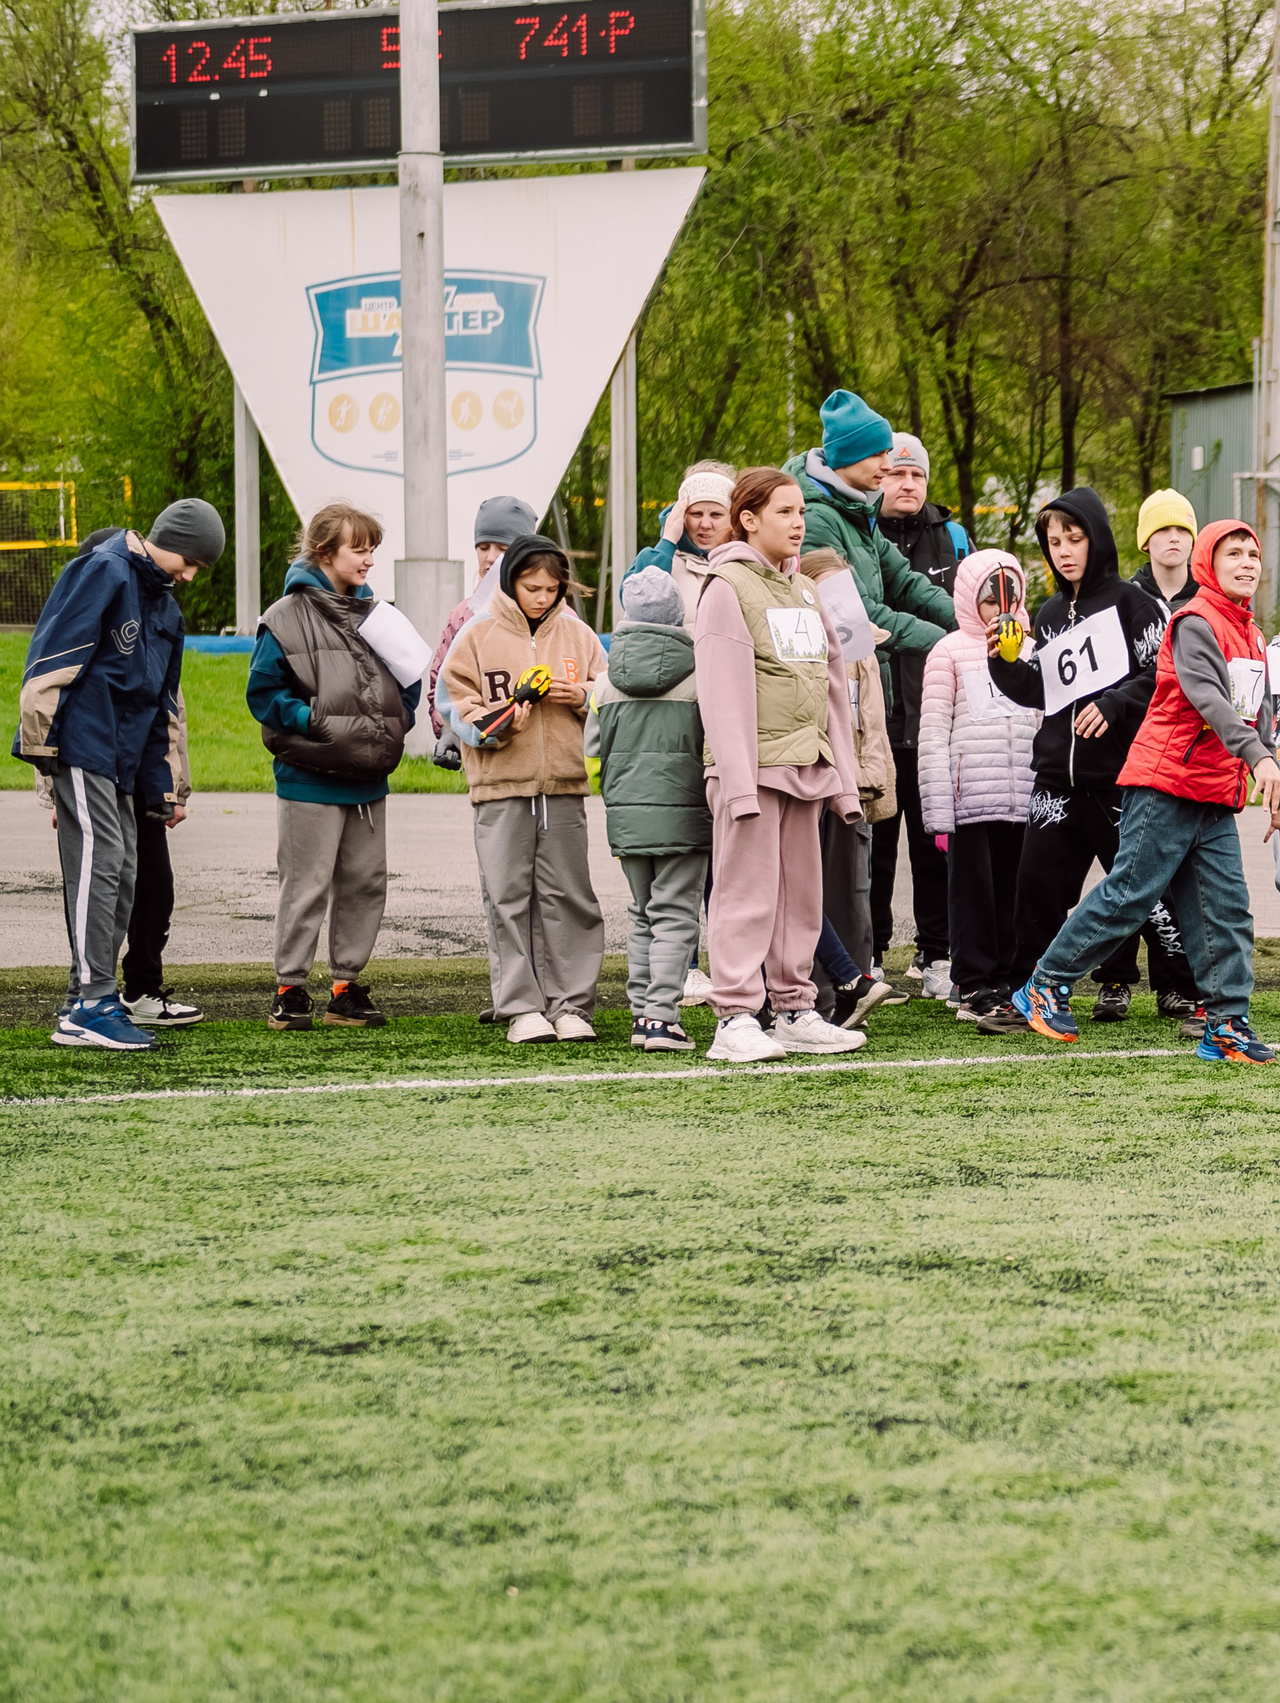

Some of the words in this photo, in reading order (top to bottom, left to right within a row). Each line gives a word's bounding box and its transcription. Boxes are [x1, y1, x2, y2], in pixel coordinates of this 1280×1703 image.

[162, 36, 272, 83] 12.45
[349, 310, 501, 333] ШАТЕР
[795, 611, 812, 647] 4
[1057, 635, 1099, 686] 61
[484, 670, 514, 703] R
[563, 659, 579, 683] B
[1250, 668, 1263, 704] 7
